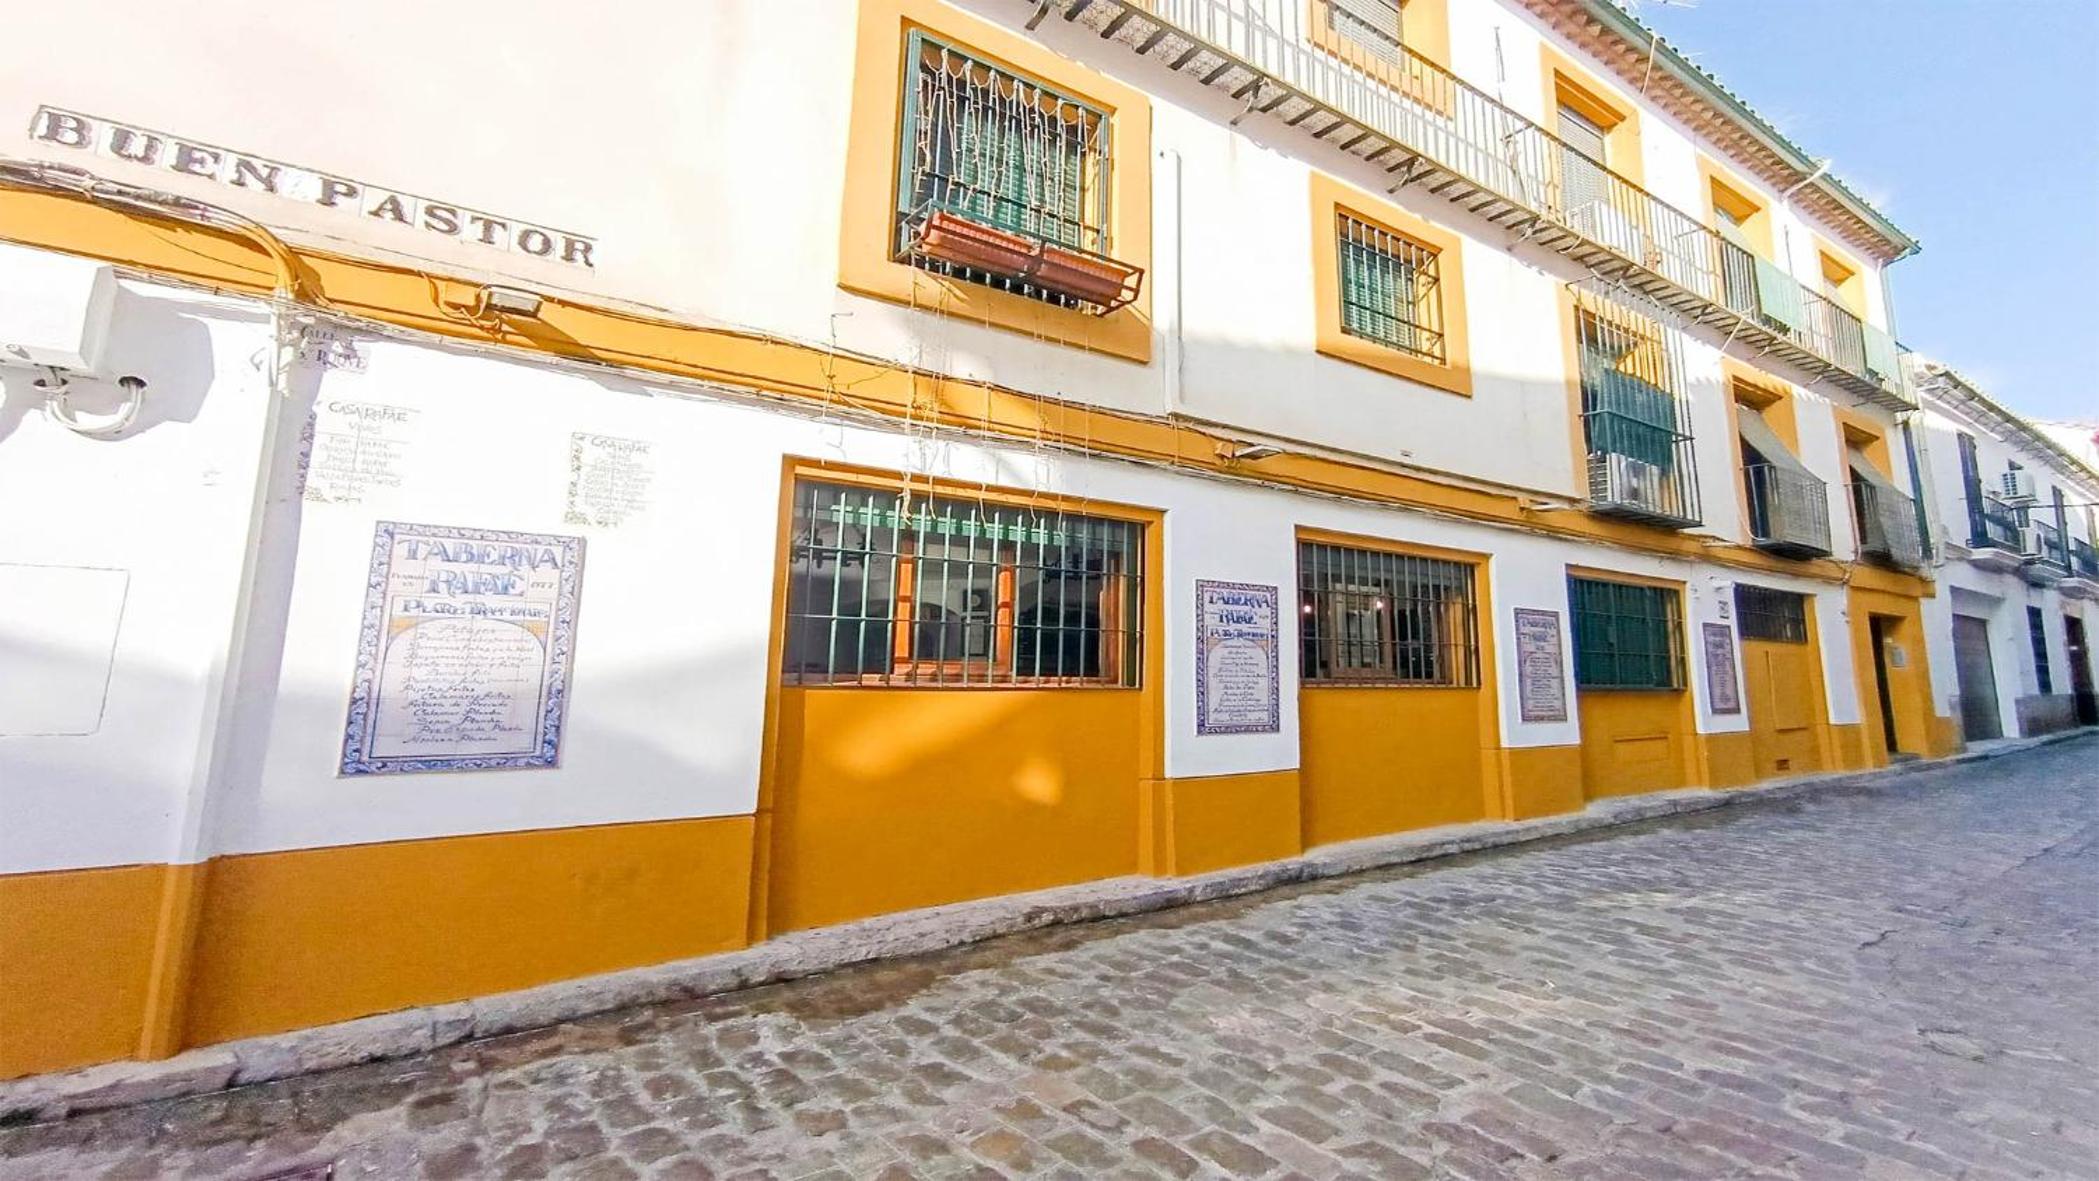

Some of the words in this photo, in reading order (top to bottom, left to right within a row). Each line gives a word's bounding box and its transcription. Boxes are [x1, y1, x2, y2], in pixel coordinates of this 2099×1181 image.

[38, 111, 280, 193] BUEN
[316, 175, 595, 267] PASTOR
[398, 538, 560, 571] TABERNA
[1205, 590, 1270, 608] TABERNA
